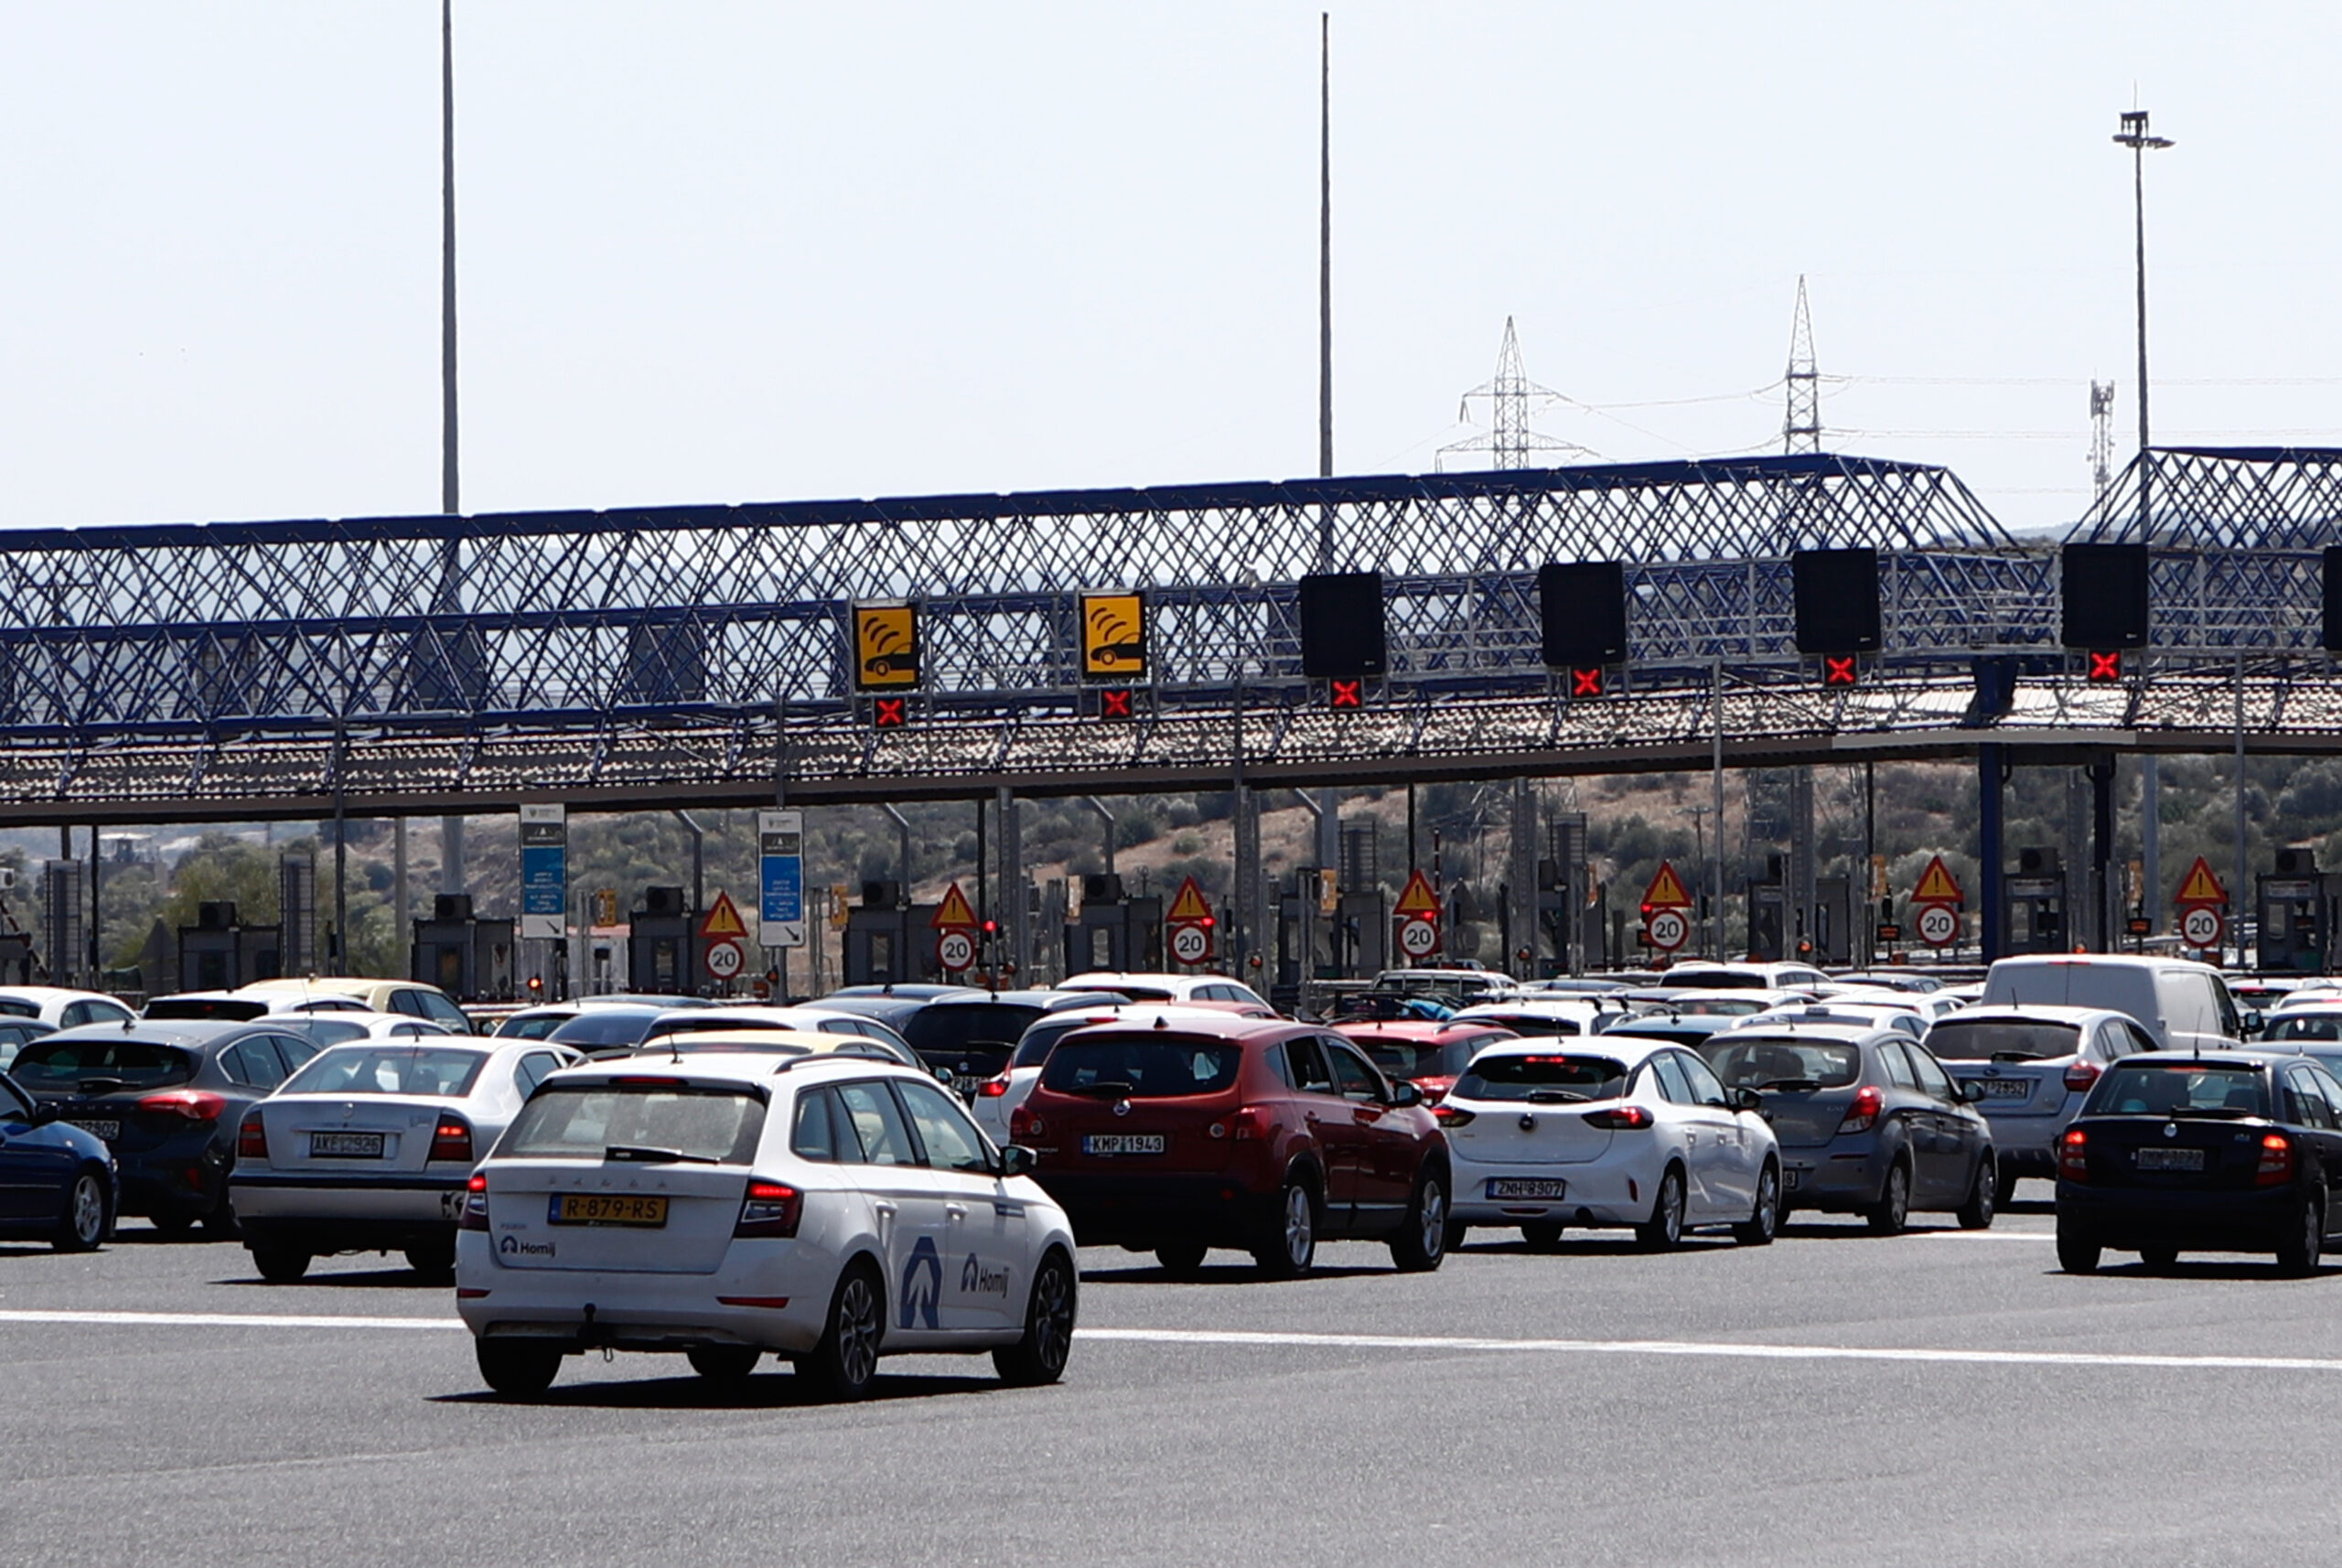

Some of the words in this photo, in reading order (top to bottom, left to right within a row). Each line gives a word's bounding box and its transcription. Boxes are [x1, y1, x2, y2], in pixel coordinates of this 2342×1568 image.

[1655, 920, 1680, 939] 20
[1925, 916, 1950, 933] 20
[2189, 917, 2214, 935] 20
[1177, 935, 1202, 953] 20
[1407, 929, 1432, 946] 20
[713, 950, 736, 968] 20
[945, 941, 968, 959] 20
[565, 1198, 658, 1219] R-879-RS
[520, 1241, 556, 1258] Homij
[978, 1266, 1010, 1299] Homij
